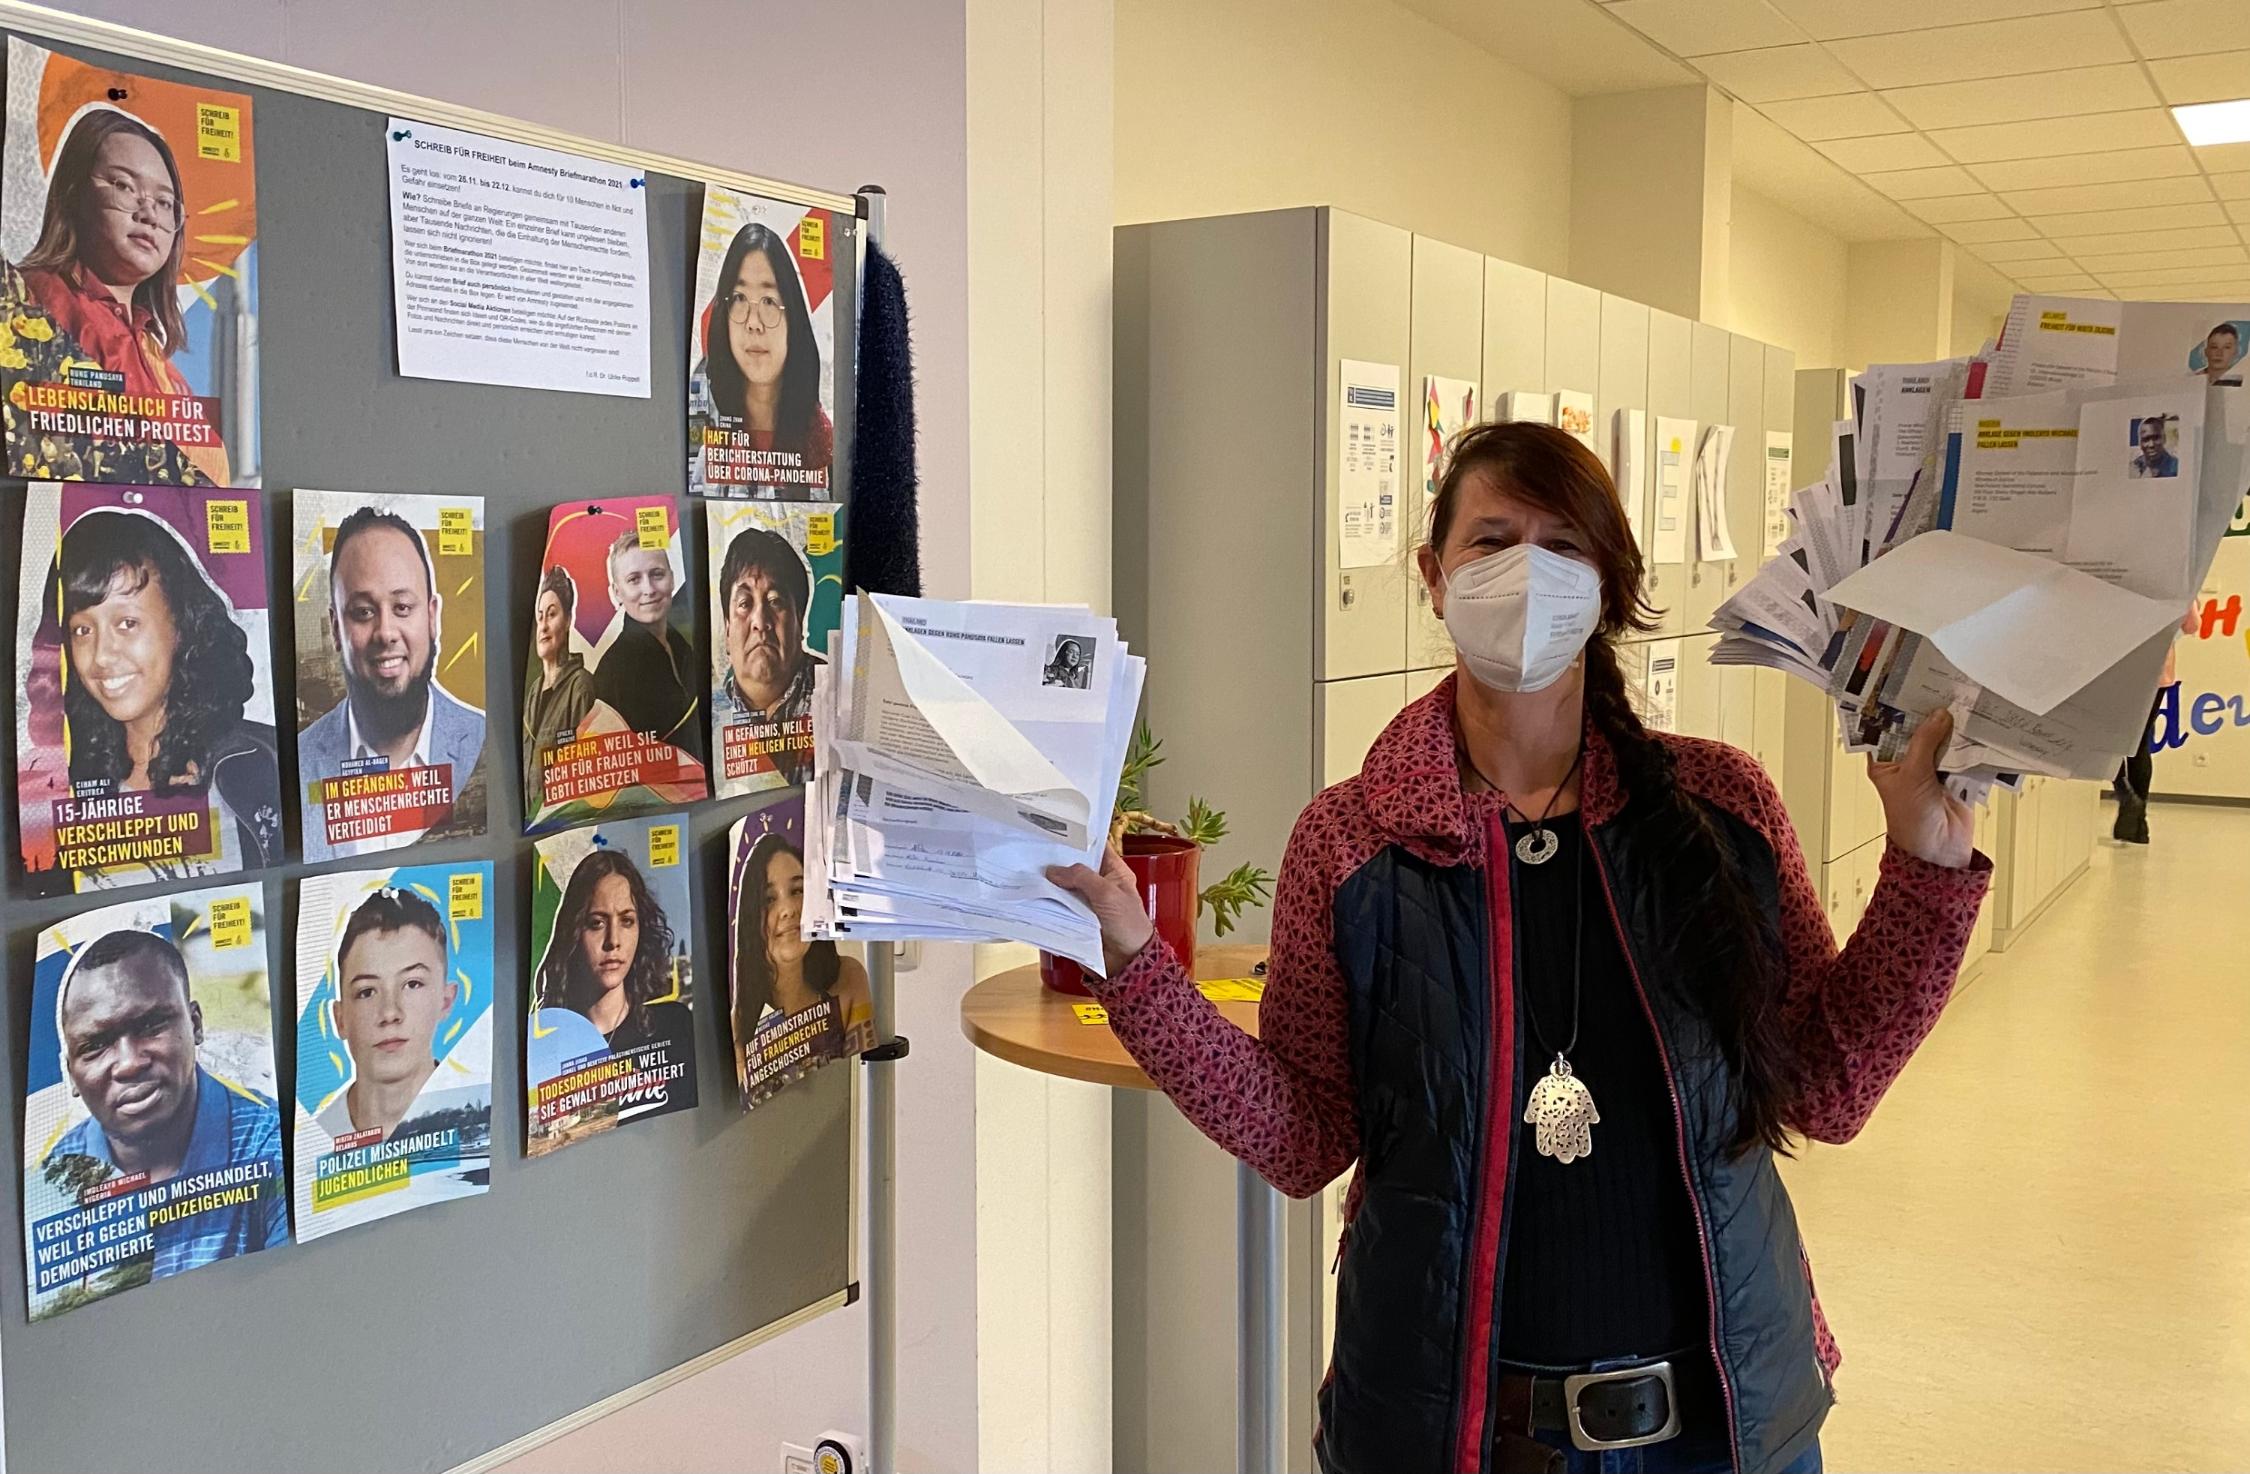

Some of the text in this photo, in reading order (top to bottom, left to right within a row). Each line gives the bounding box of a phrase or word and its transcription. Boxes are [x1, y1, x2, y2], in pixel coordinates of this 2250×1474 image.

[414, 140, 622, 188] SCHREIB FÜR FREIHEIT beim Amnesty Briefmarathon 2021
[402, 191, 420, 200] Wie?
[480, 179, 490, 188] bis
[29, 386, 204, 420] LEBENSLÄNGLICH FÜR
[31, 411, 211, 442] FRIEDLICHEN PROTEST
[707, 430, 750, 447] HAFT FÜR
[707, 448, 802, 466] BERICHTERSTATTUNG
[707, 462, 823, 484] ÜBER CORONA-PANDEMIE
[544, 730, 658, 766] IN GEFAHR, WEIL SIE
[725, 720, 813, 743] IM GEFÄNGNIS, WEIL E
[544, 746, 672, 784] SICH FÜR FRAUEN UND
[726, 744, 747, 760] EINEN
[748, 738, 784, 756] HEILIGEN
[100, 778, 110, 786] ALI
[325, 769, 441, 799] IM GEFÄNGNIS, WEIL
[727, 758, 757, 777] SCHÜTZT
[545, 769, 639, 802] LGBTI EINSETZEN
[57, 796, 144, 823] 15-JÄHRIGE
[327, 788, 449, 820] ER MENSCHENRECHTE
[57, 812, 198, 846] VERSCHLEPPT UND
[328, 815, 392, 841] VERTEIDIGT
[58, 836, 182, 870] VERSCHWUNDEN
[746, 1038, 758, 1057] AUF
[761, 1002, 831, 1047] DEMONSTRATION
[748, 1053, 762, 1072] FÜR
[763, 1018, 829, 1061] FRAUENRECHTE
[540, 1058, 636, 1102] TODESDROHUNGEN,
[639, 1050, 669, 1069] WEIL
[750, 1042, 810, 1088] ANGESCHOSSEN
[540, 1103, 556, 1120] SIE
[559, 1088, 598, 1113] GEWALT
[600, 1063, 685, 1098] DOKUMENTIERT
[320, 1129, 455, 1177] POLIZEI MISSHANDELT
[319, 1159, 408, 1197] JUGENDLICHEN
[36, 1161, 273, 1243] VERSCHLEPPT UND MISSHANDELT,
[38, 1184, 260, 1265] WEIL ER GEGEN POLIZEIGEWALT
[40, 1233, 155, 1287] DEMONSTRIERTE
